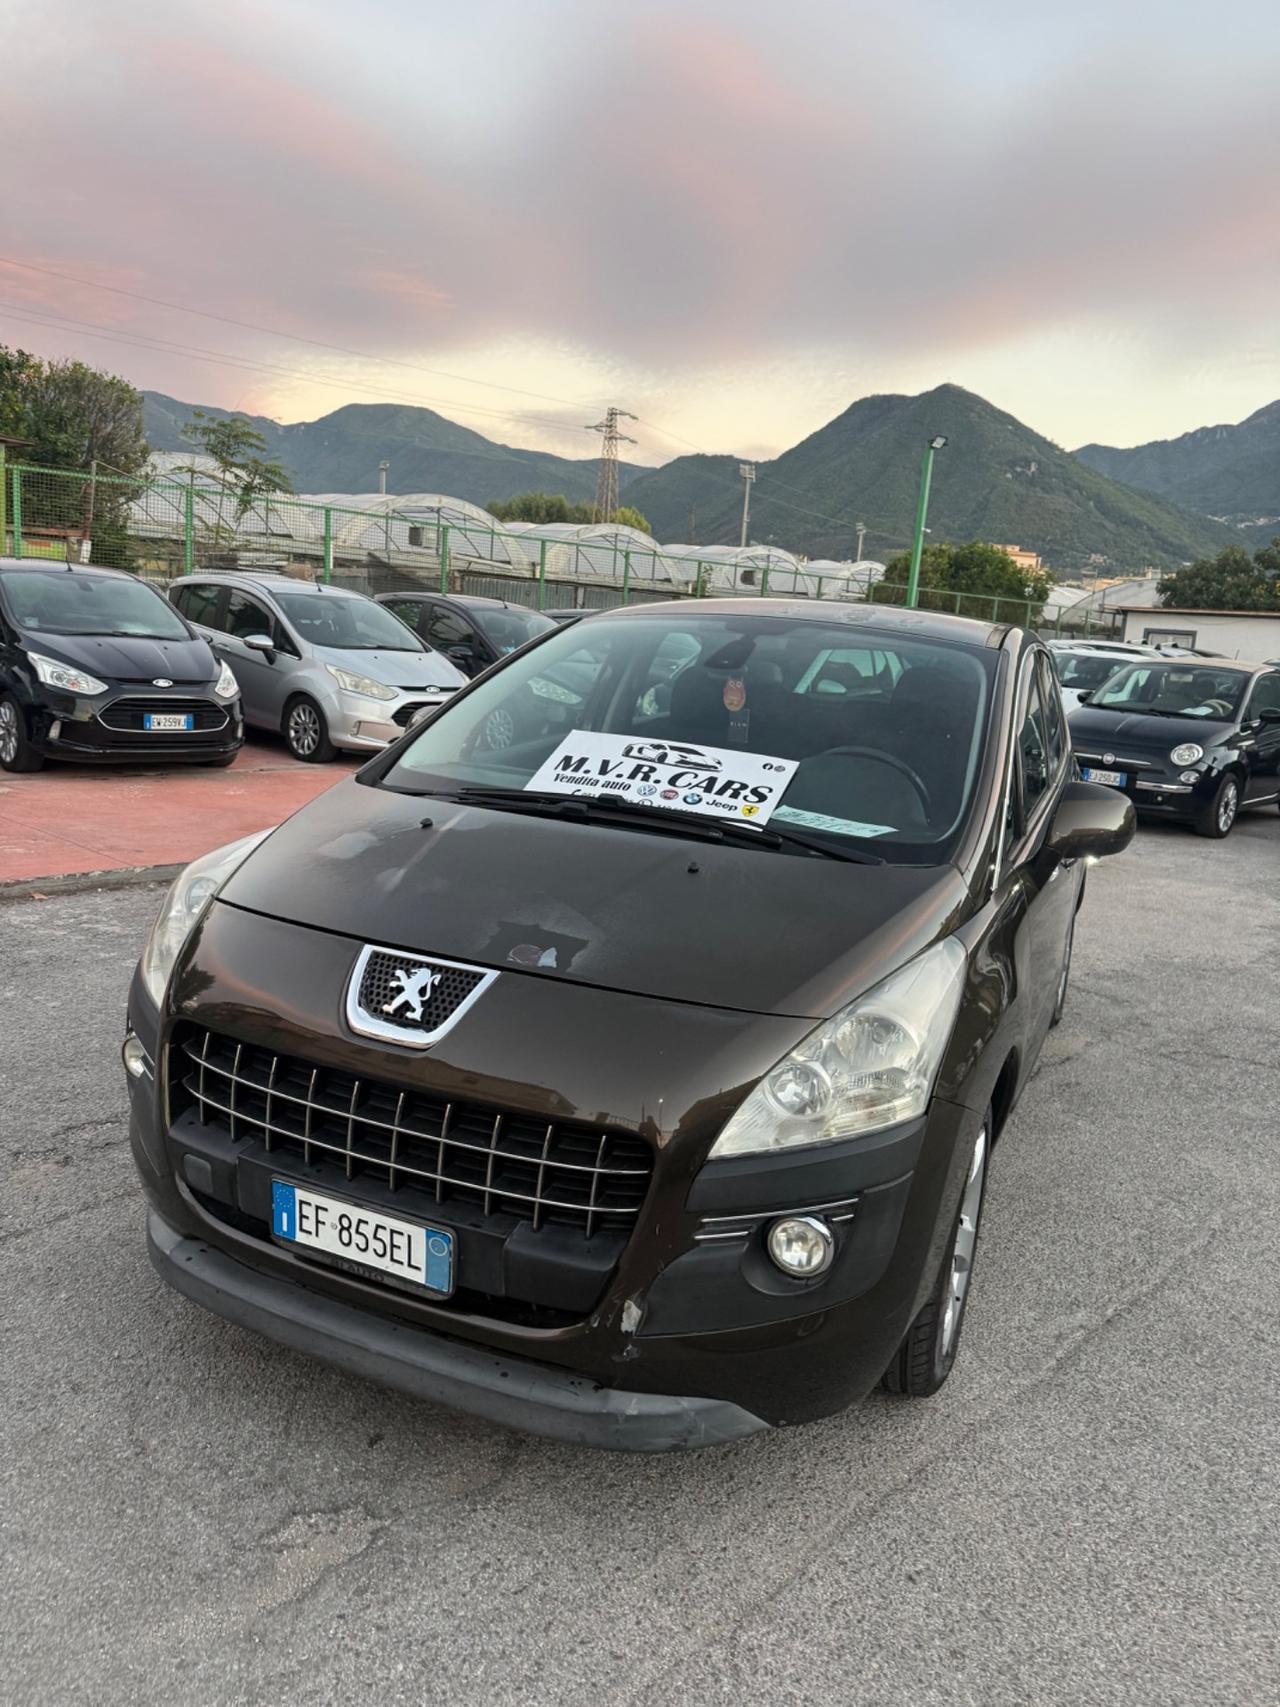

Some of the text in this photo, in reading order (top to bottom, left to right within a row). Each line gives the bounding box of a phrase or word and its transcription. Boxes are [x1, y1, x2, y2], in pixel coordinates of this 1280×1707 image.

[553, 774, 631, 792] Vendita auto
[706, 799, 738, 813] Jeep
[298, 1199, 328, 1237] EF
[338, 1213, 422, 1271] 855EL
